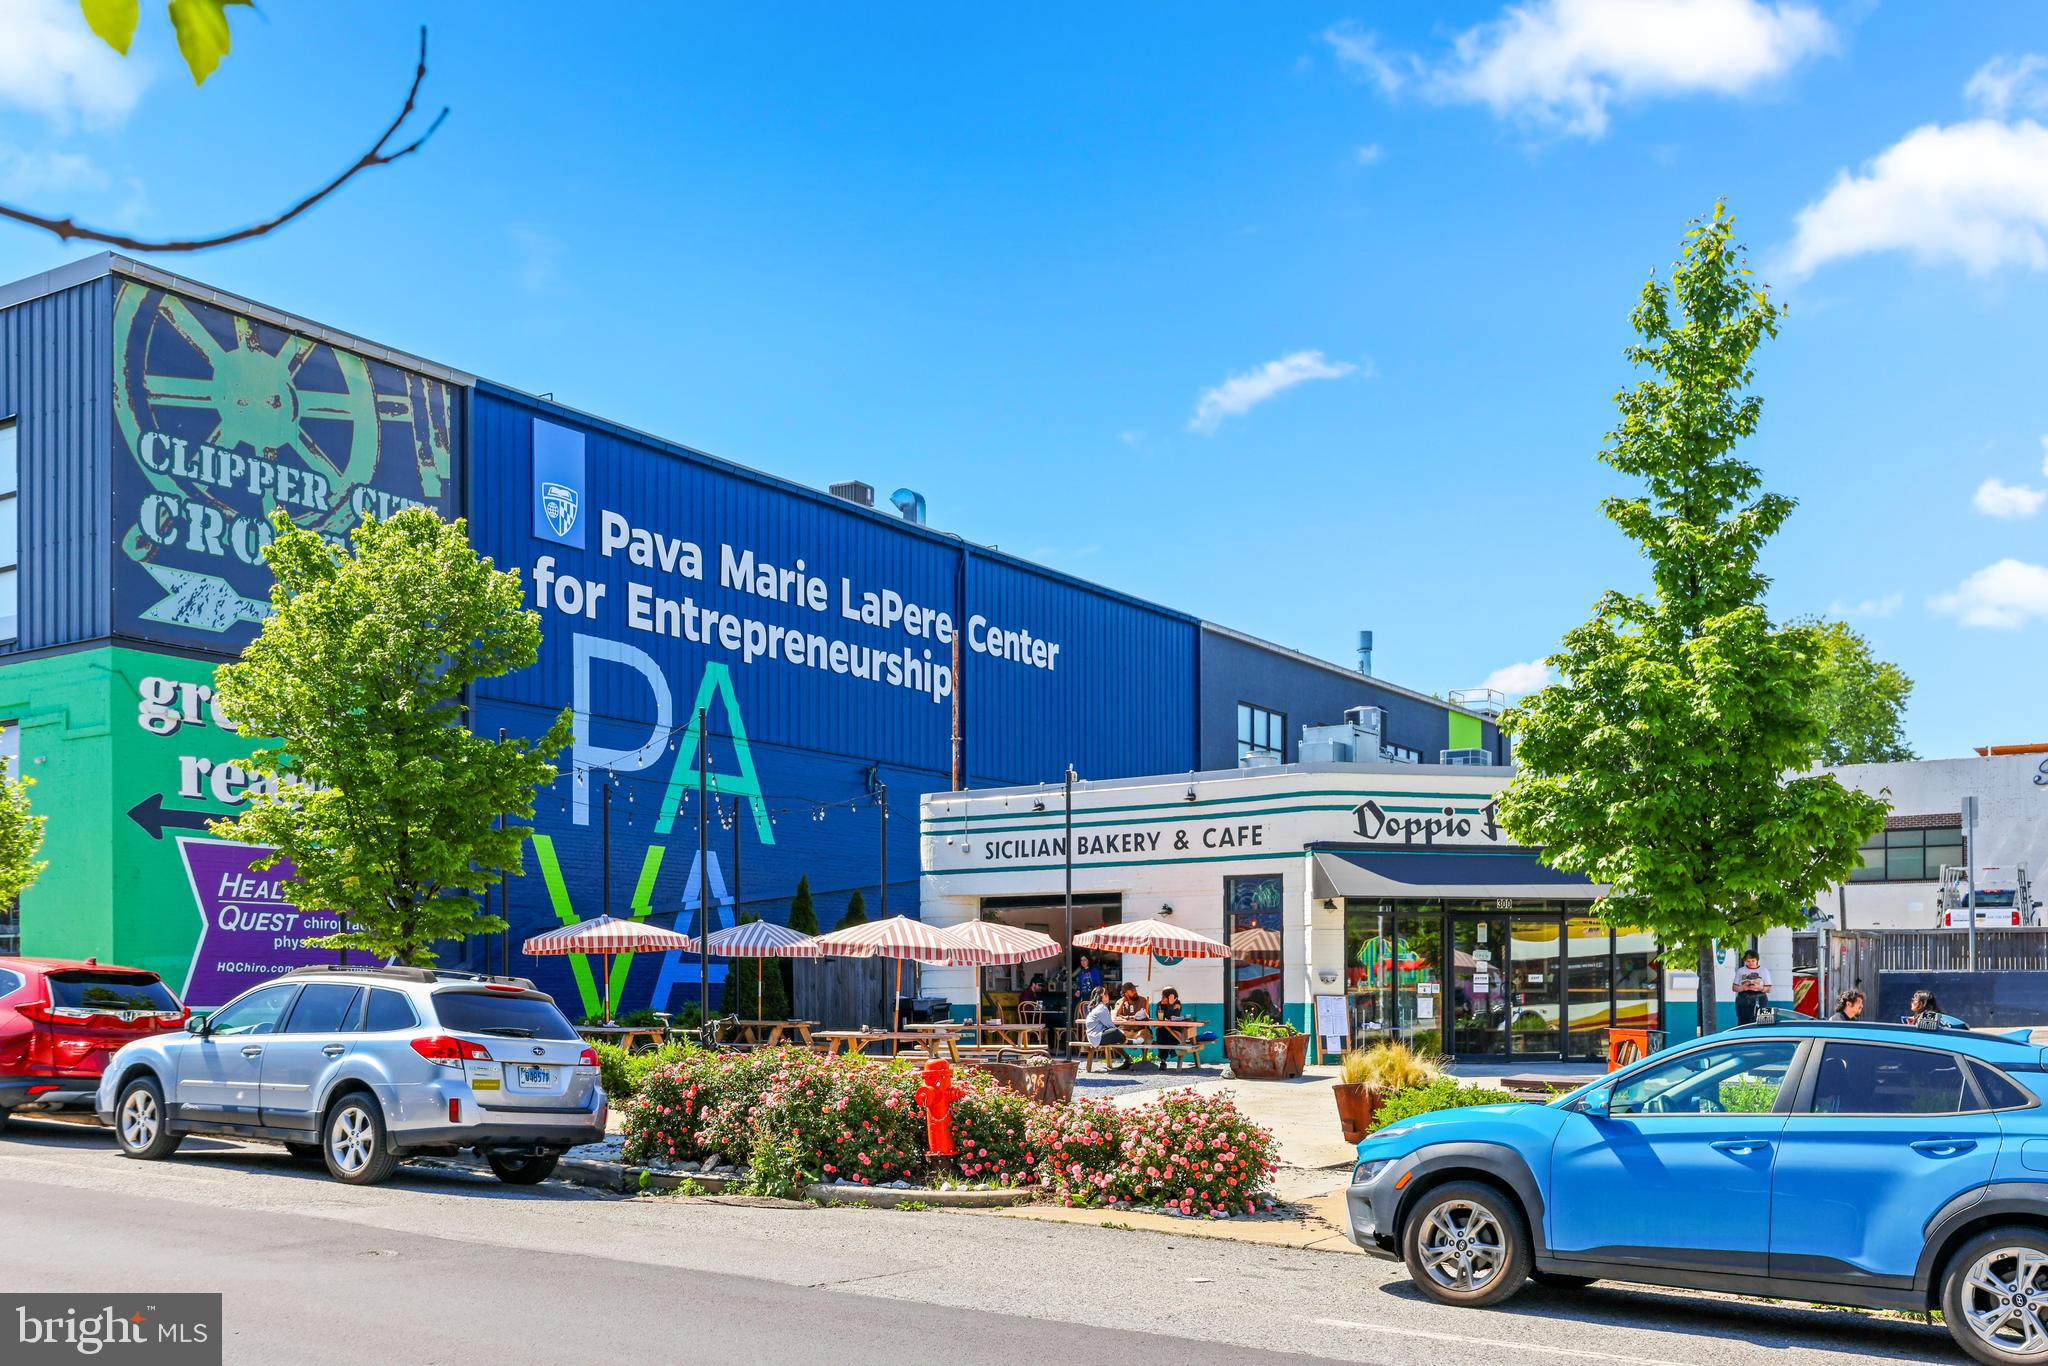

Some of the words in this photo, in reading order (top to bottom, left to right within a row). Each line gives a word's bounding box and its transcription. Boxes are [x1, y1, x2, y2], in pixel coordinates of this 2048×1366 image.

[141, 431, 330, 512] CLIPPER
[352, 486, 440, 523] CI
[601, 509, 703, 581] Pava
[720, 543, 828, 612] Marie
[841, 577, 954, 644] LaPere
[968, 614, 1060, 671] Center
[532, 555, 606, 619] for
[628, 583, 953, 704] Entrepreneurship
[985, 837, 1067, 860] SICILIAN
[1077, 831, 1161, 855] BAKERY
[1173, 829, 1189, 850] &
[1202, 824, 1263, 849] CAFE
[1352, 800, 1471, 845] Doppio
[218, 872, 283, 900] HEAL
[218, 905, 300, 932] QUEST
[217, 962, 295, 973] HQChiro.com
